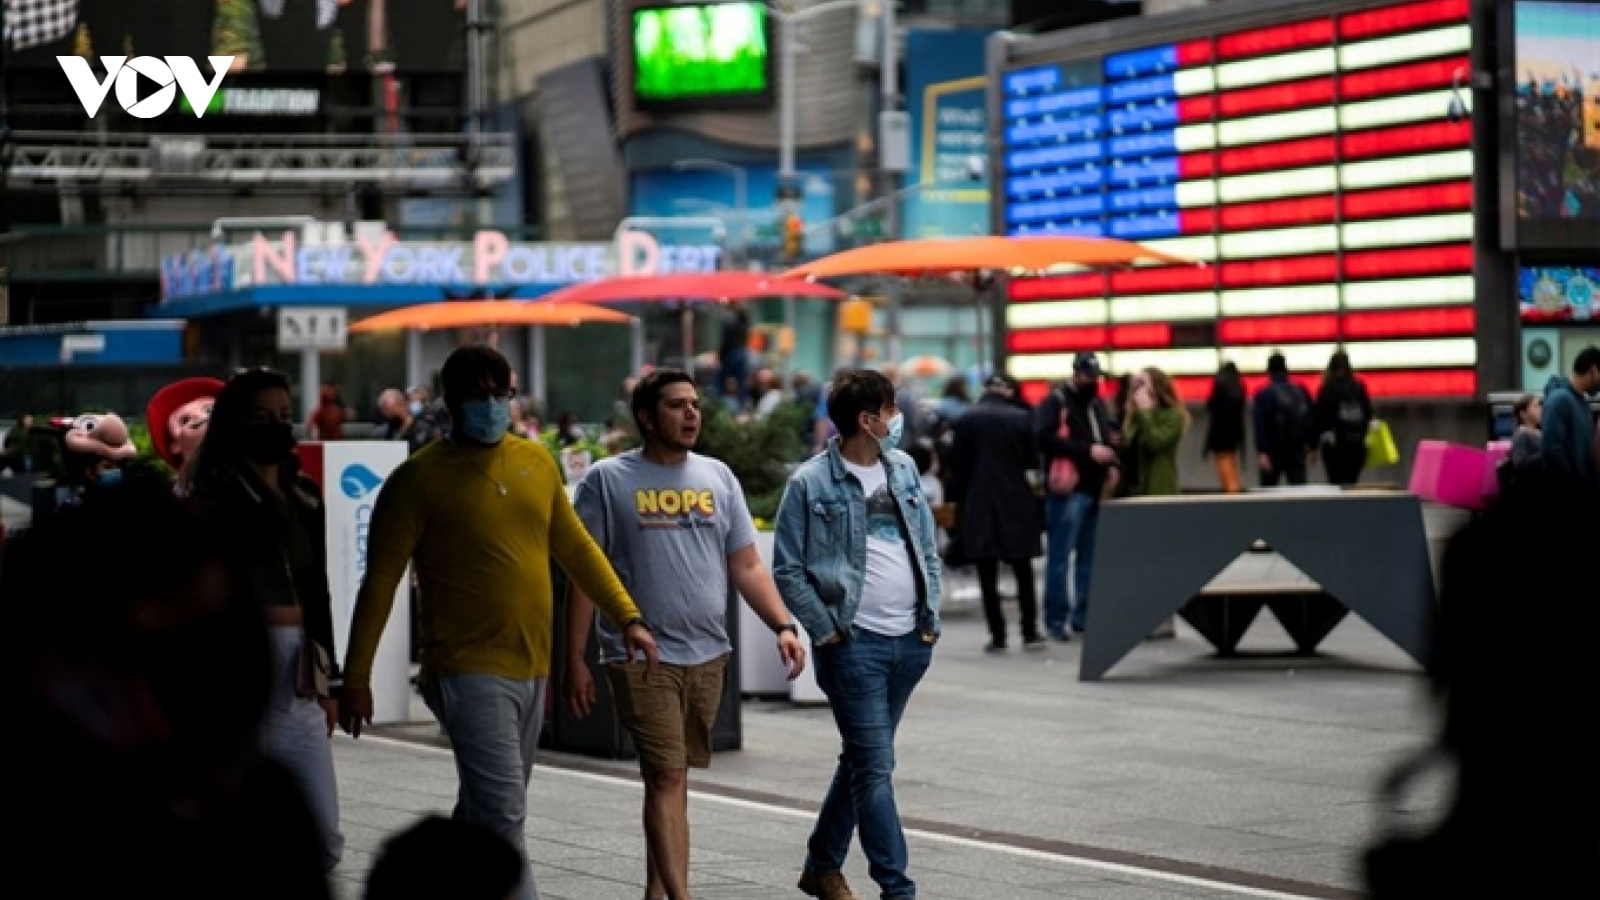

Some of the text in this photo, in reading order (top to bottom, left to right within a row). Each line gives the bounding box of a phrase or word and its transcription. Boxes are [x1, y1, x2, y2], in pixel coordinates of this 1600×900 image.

[252, 230, 352, 282] NEW
[356, 229, 466, 284] YORK
[473, 229, 606, 285] POLICE
[635, 489, 716, 516] NOPE
